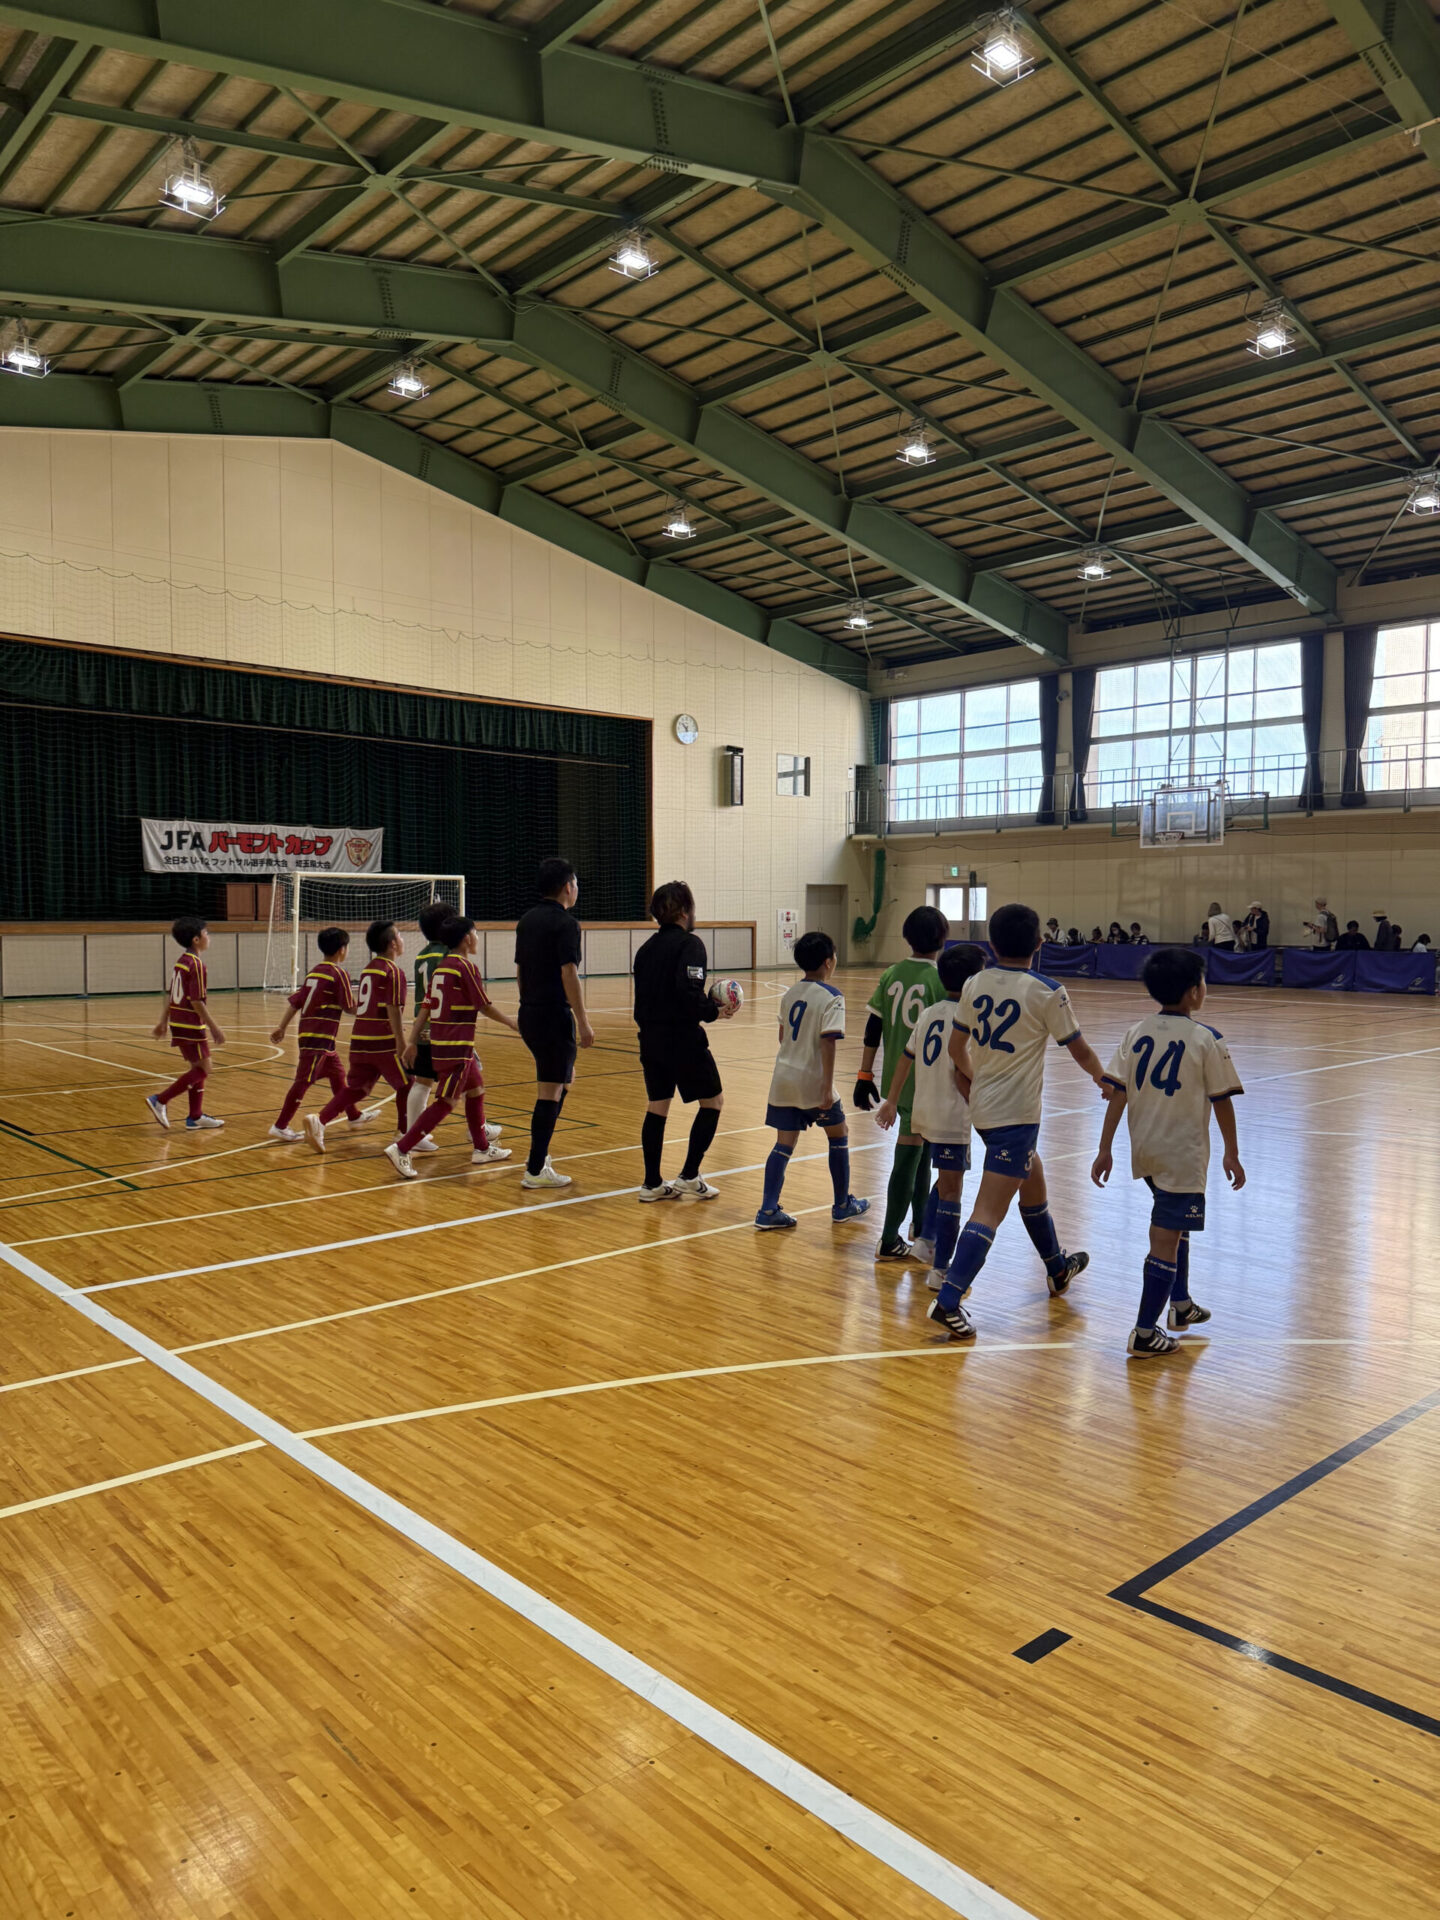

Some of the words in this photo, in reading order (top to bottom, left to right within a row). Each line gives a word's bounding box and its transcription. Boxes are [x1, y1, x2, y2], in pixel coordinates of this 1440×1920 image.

[160, 830, 207, 852] JFA
[301, 978, 318, 1014] 7
[356, 975, 373, 1015] 9
[430, 974, 446, 1019] 5
[788, 1000, 808, 1041] 9
[972, 994, 1021, 1054] 32
[923, 1019, 943, 1067] 6
[1132, 1035, 1186, 1097] 14
